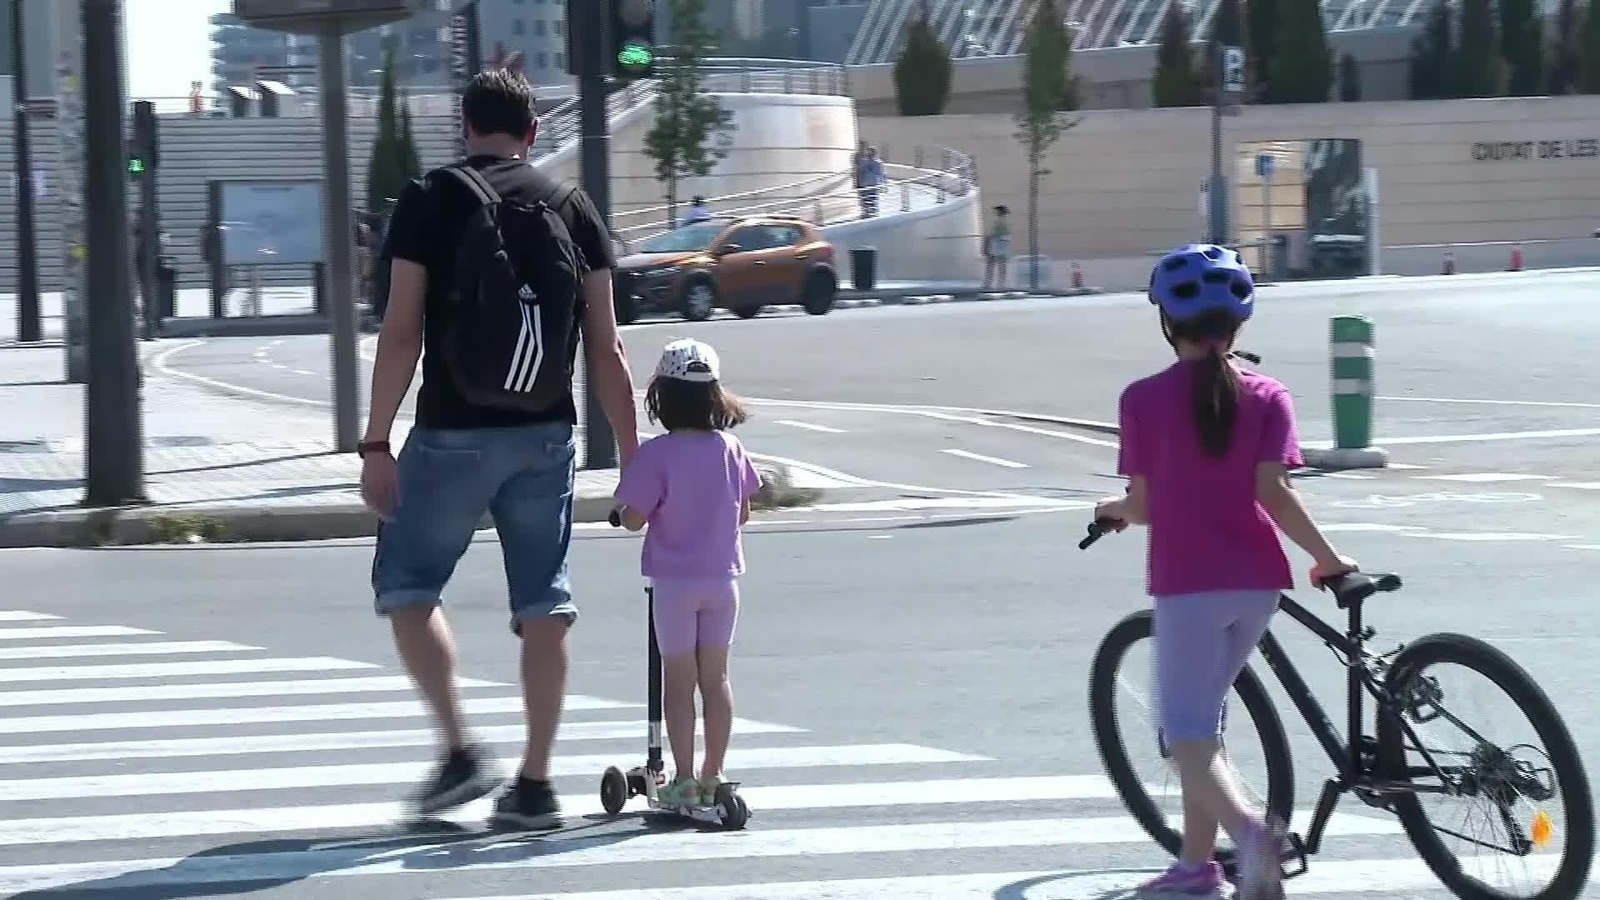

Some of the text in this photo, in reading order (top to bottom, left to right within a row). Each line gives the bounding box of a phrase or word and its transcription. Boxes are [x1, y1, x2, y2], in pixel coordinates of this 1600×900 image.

[1471, 138, 1598, 161] CIUTAT DE LES
